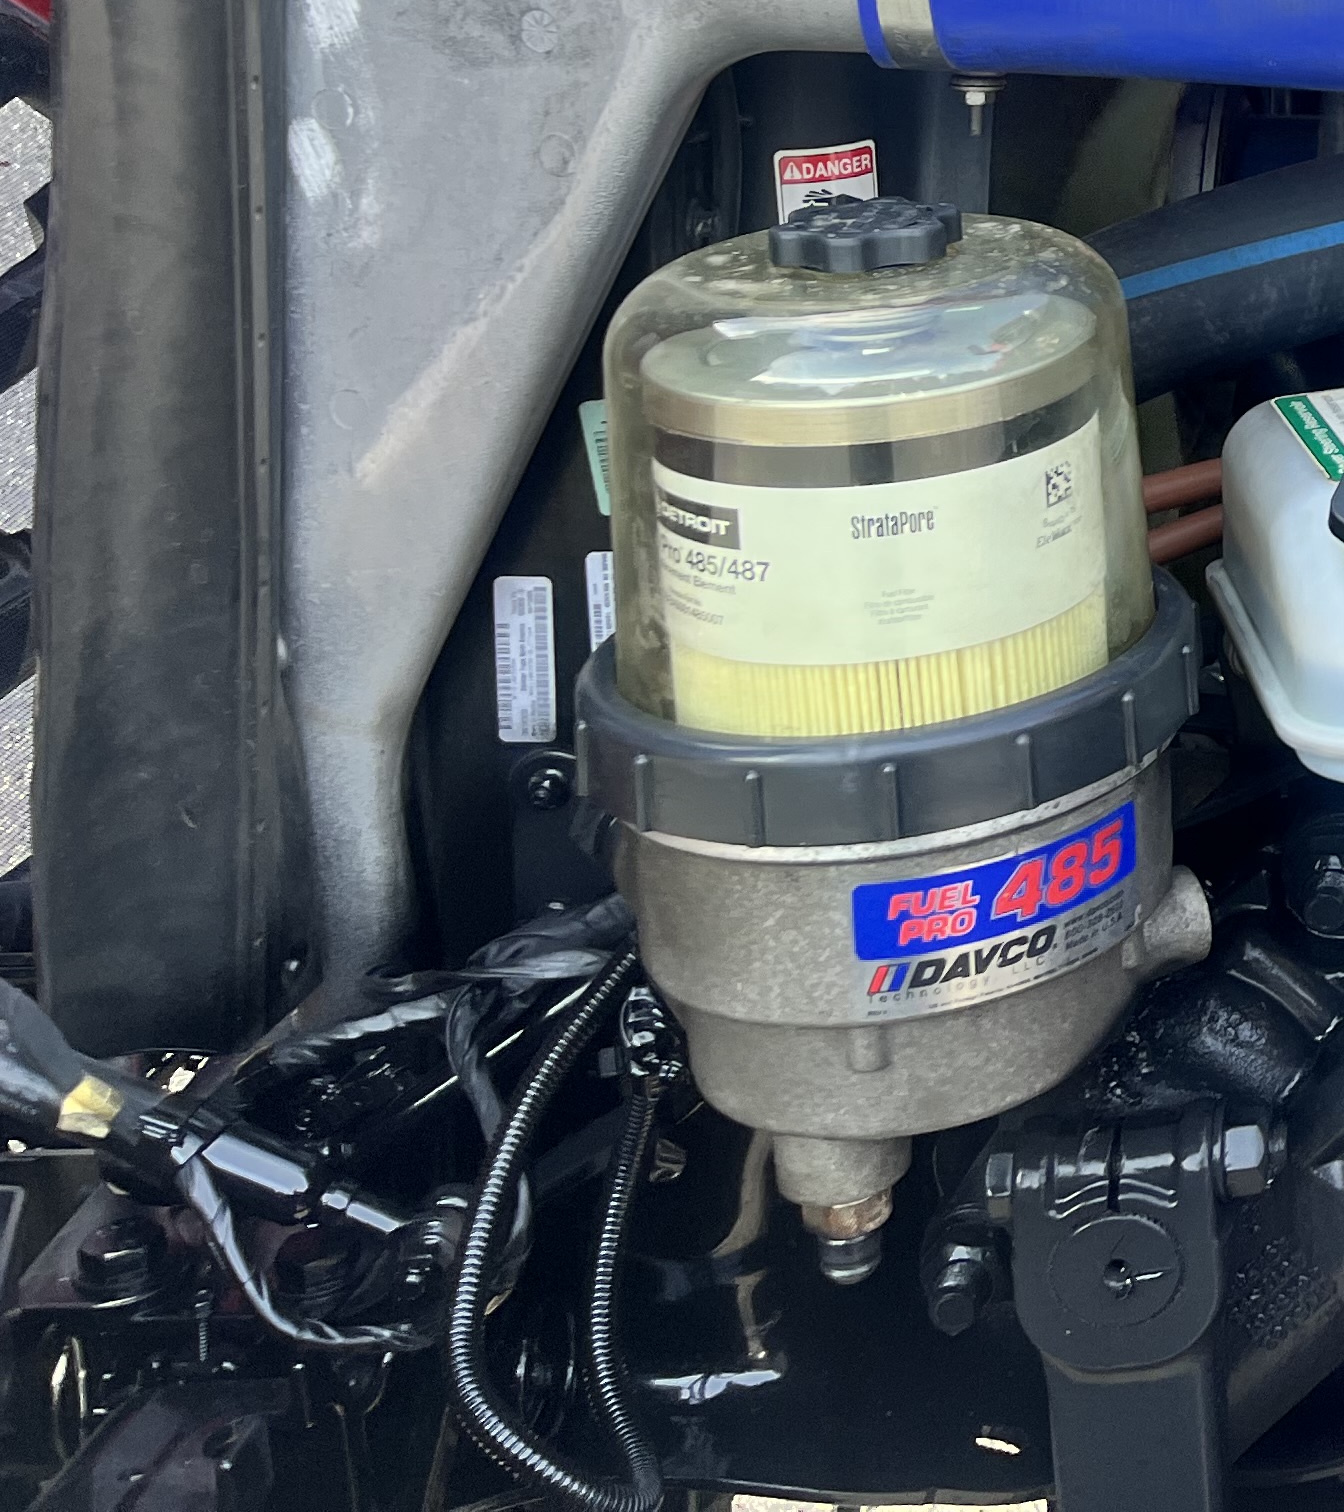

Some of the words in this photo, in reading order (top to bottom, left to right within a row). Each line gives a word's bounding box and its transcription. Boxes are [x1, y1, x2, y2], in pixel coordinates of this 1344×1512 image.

[802, 154, 872, 180] DANGER
[851, 509, 935, 540] StrataPore
[686, 548, 770, 582] 485/487
[991, 818, 1124, 922] 485
[888, 879, 981, 921] FUEL
[898, 907, 978, 947] PRO
[909, 925, 1058, 989] DAVCO
[1012, 955, 1046, 975] LLC
